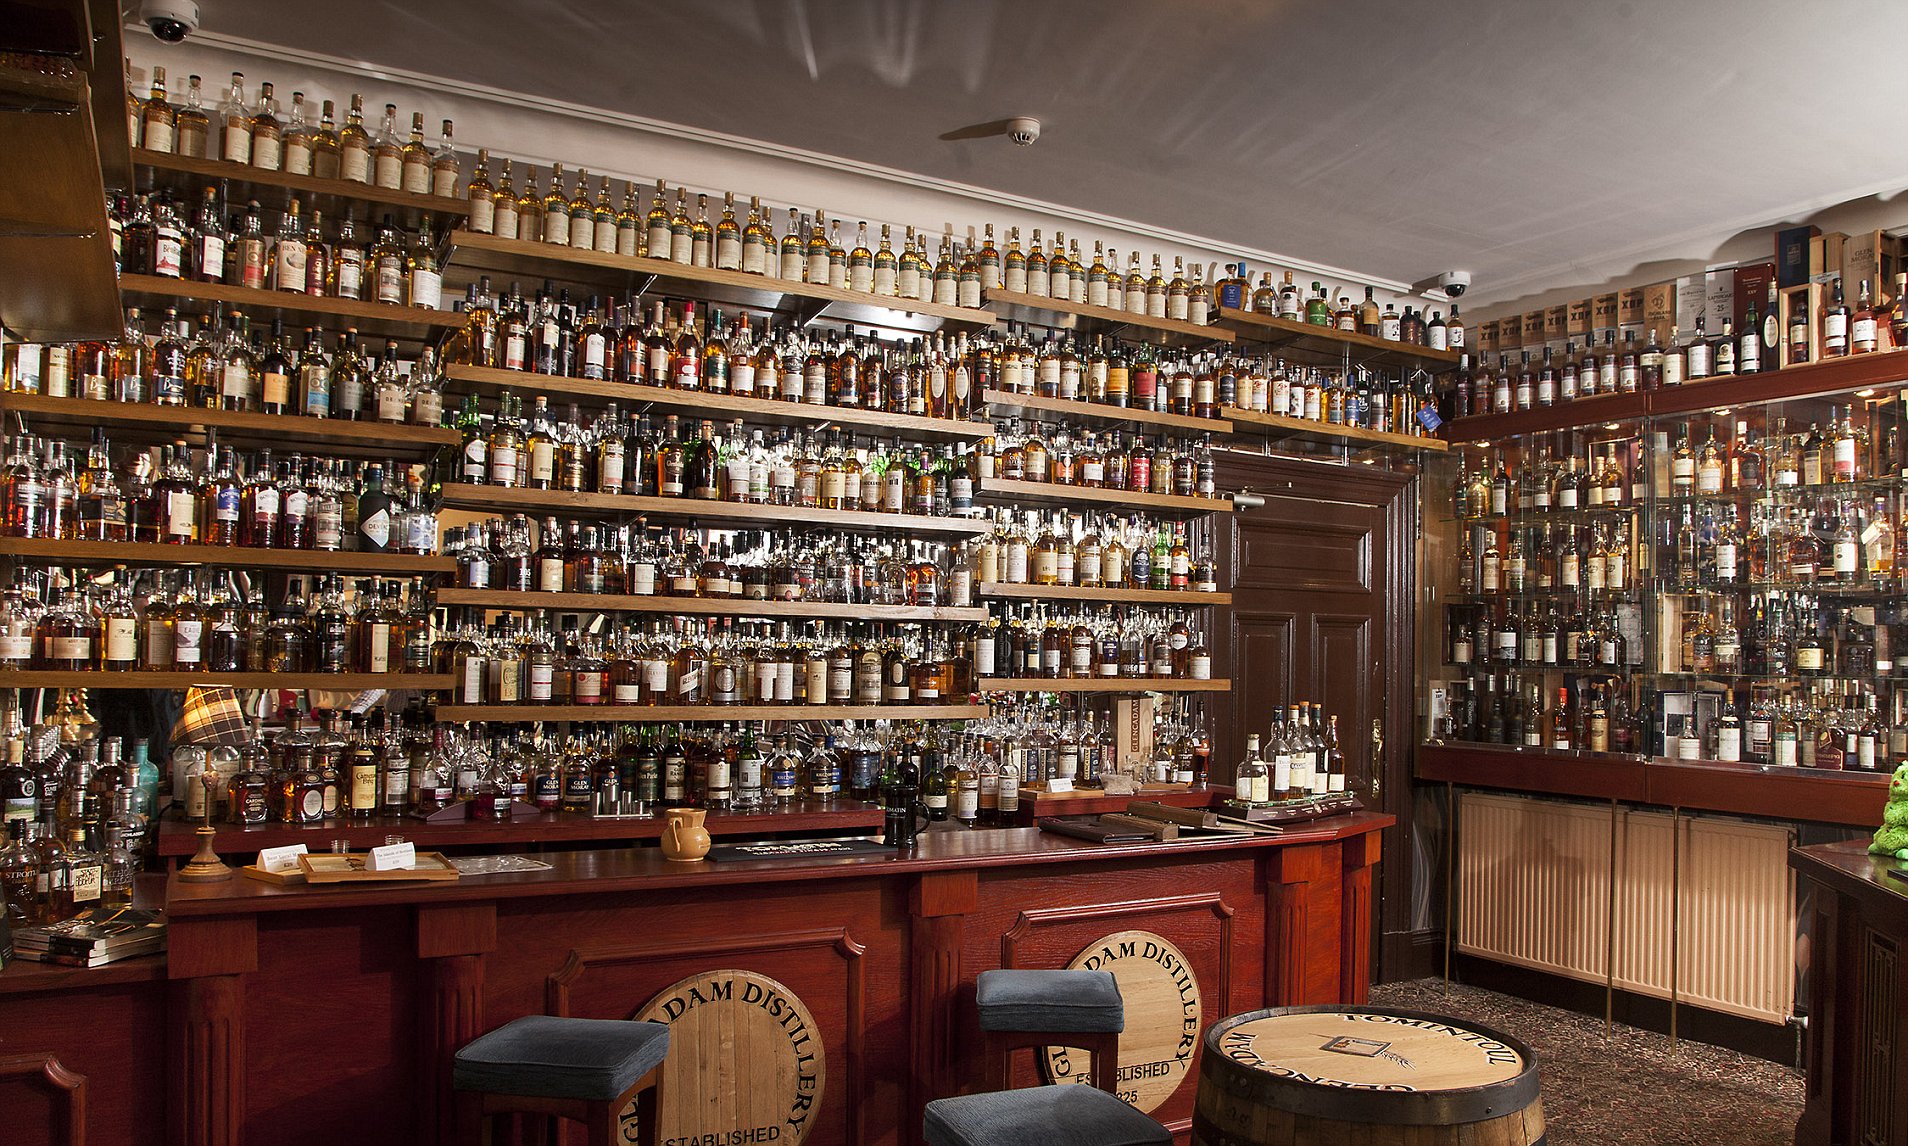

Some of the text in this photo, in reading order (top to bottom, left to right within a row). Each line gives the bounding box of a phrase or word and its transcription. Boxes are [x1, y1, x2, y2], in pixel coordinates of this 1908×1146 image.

[1131, 698, 1140, 753] GLENCADAM
[1141, 941, 1199, 1071] DISTILLERY
[1340, 1014, 1518, 1067] TOMINTOUL
[740, 981, 817, 1136] DISTILLERY
